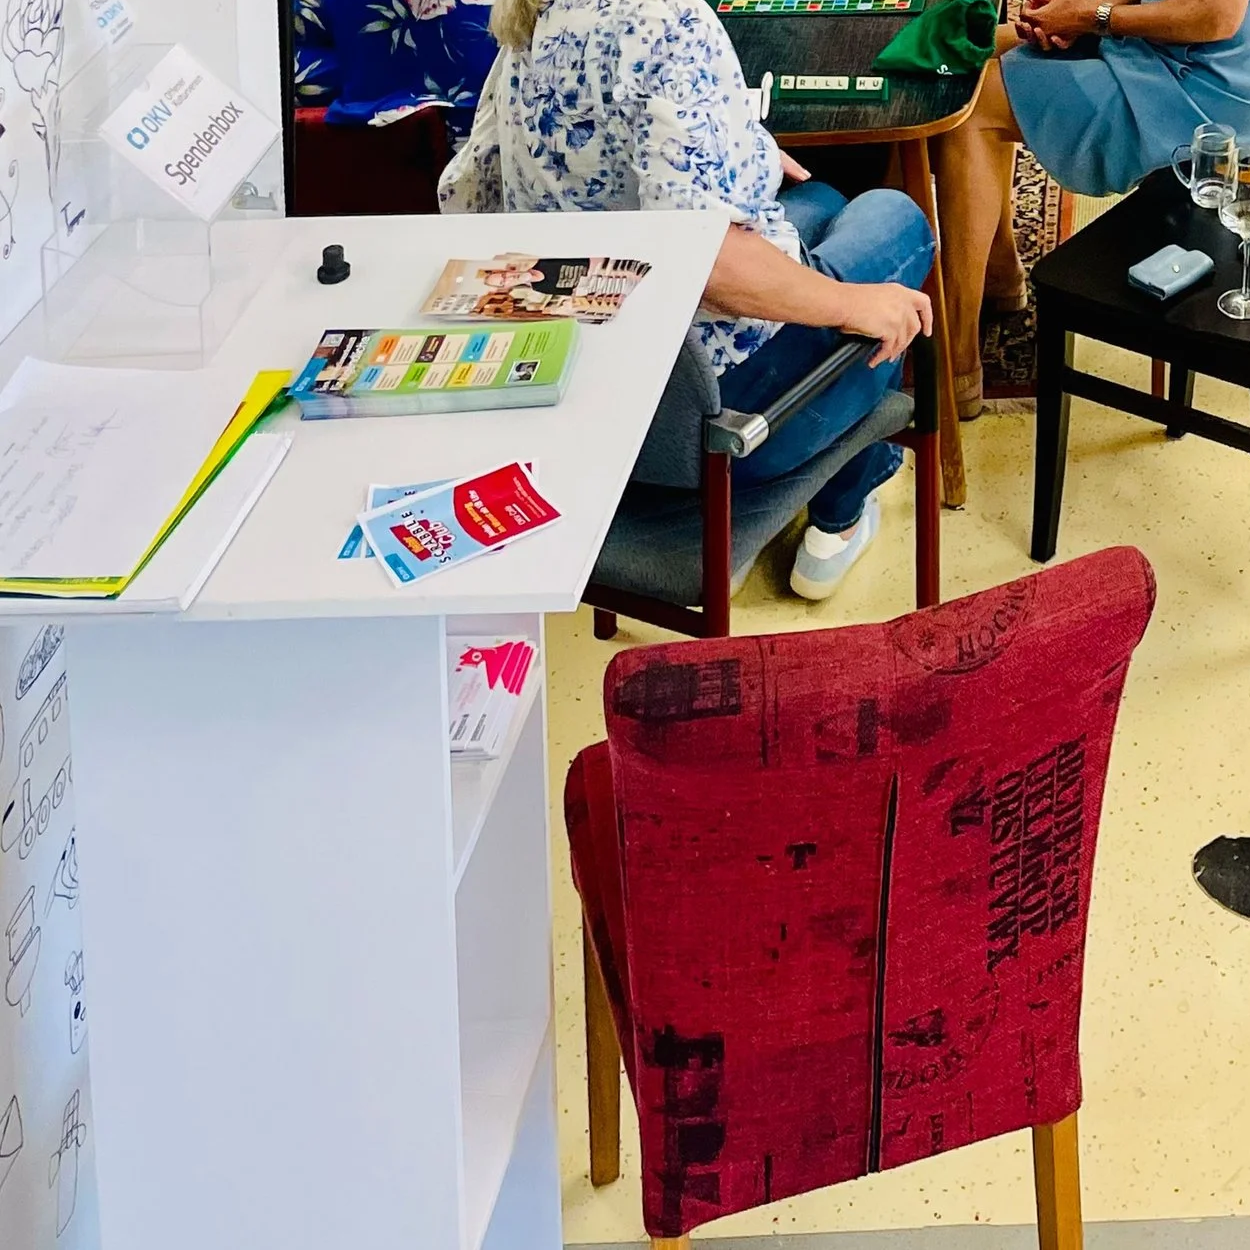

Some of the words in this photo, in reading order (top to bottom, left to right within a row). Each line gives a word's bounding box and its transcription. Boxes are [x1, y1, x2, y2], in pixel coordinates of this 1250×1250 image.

[143, 99, 174, 133] OKV
[164, 101, 244, 185] Spendenbox
[401, 511, 452, 564] SCRABBLE
[428, 521, 457, 546] Club
